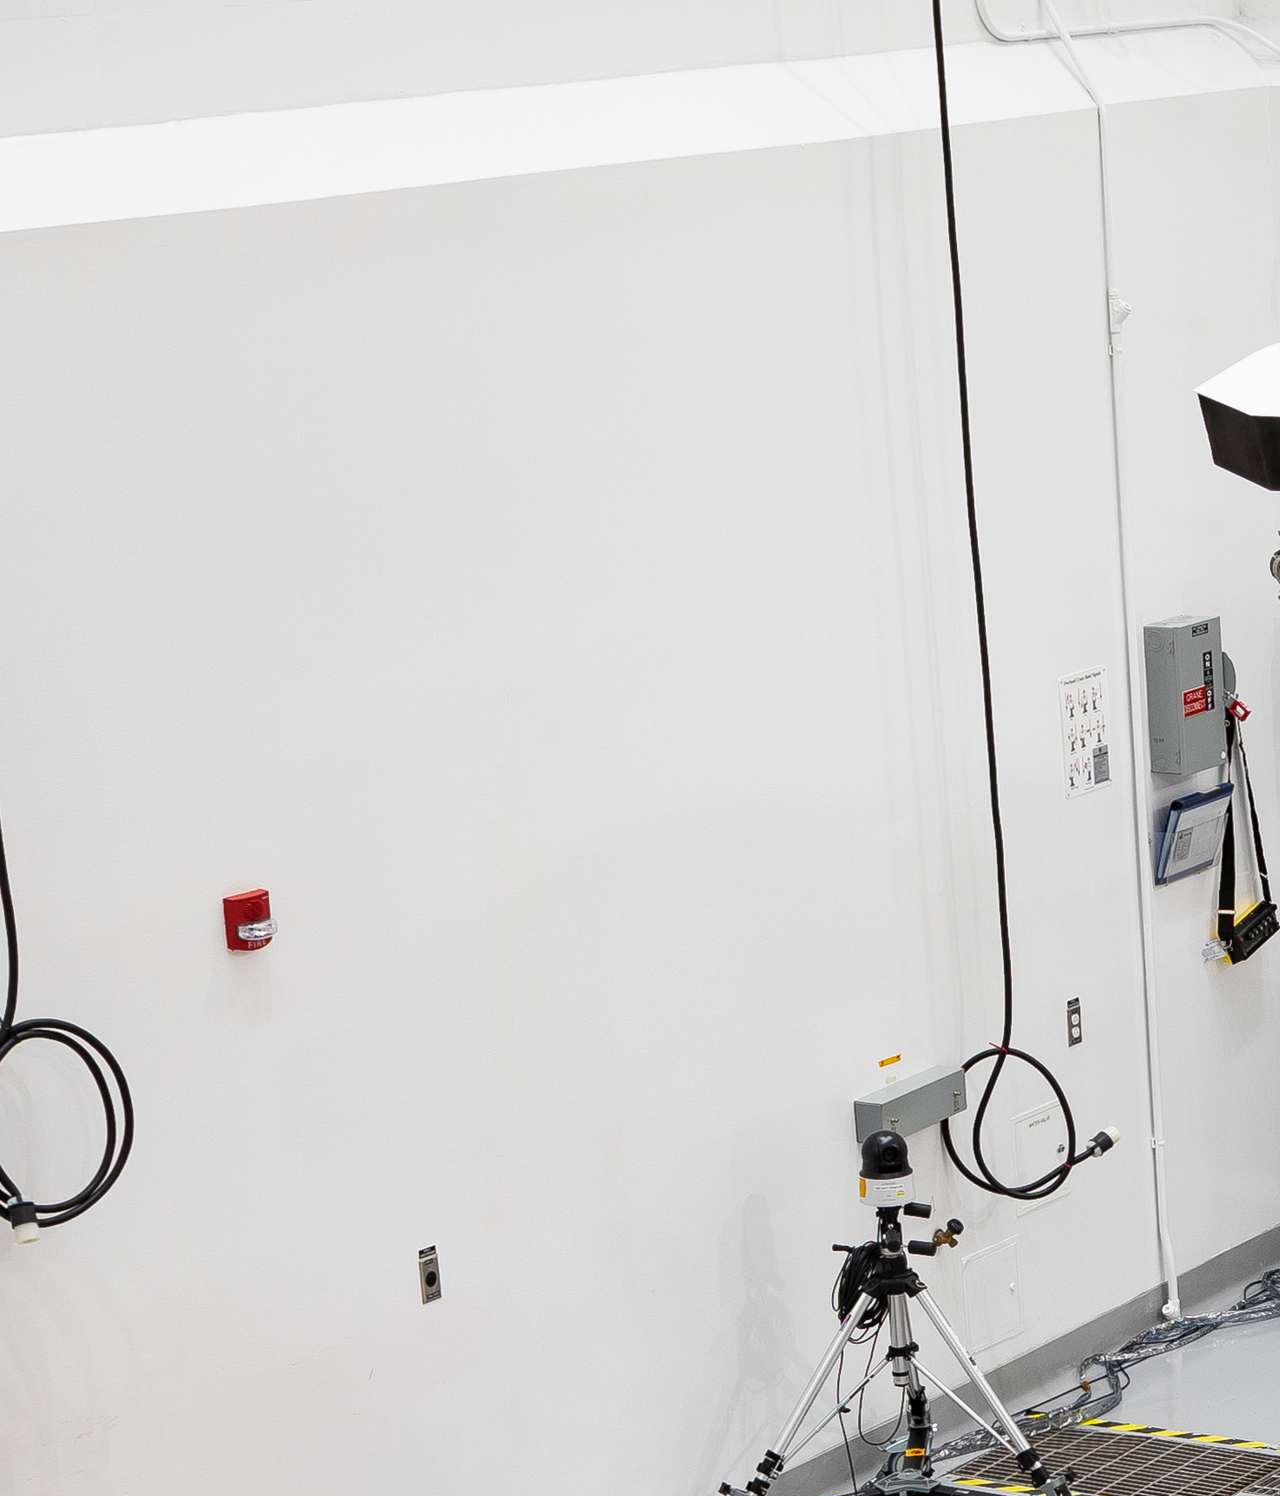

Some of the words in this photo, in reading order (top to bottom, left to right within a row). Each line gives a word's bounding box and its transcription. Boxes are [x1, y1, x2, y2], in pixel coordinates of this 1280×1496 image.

[1205, 654, 1210, 667] ON
[1186, 690, 1203, 701] CRANE
[248, 940, 267, 949] FIRE
